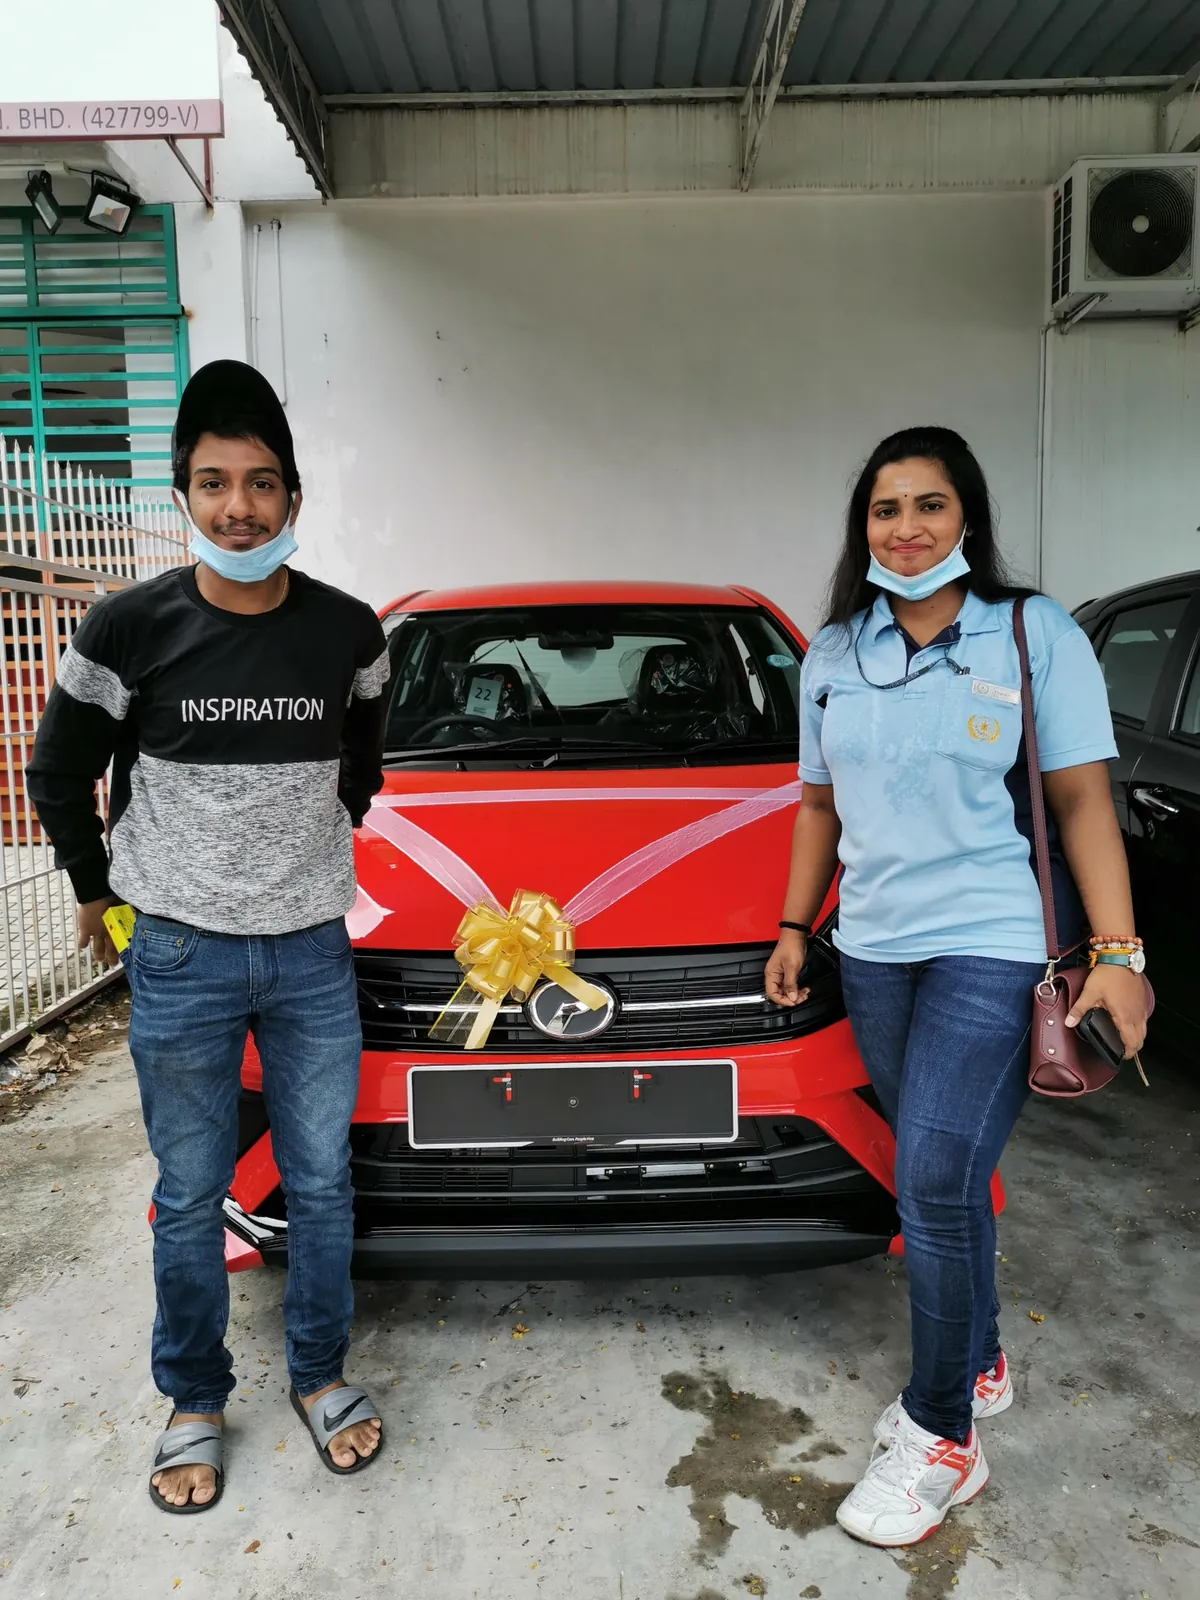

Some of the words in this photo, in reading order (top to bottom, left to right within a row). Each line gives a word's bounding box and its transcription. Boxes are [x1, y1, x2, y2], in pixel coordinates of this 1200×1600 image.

[18, 107, 72, 130] BHD.
[82, 104, 199, 132] (427799-V)
[474, 687, 492, 701] 22
[181, 697, 324, 722] INSPIRATION
